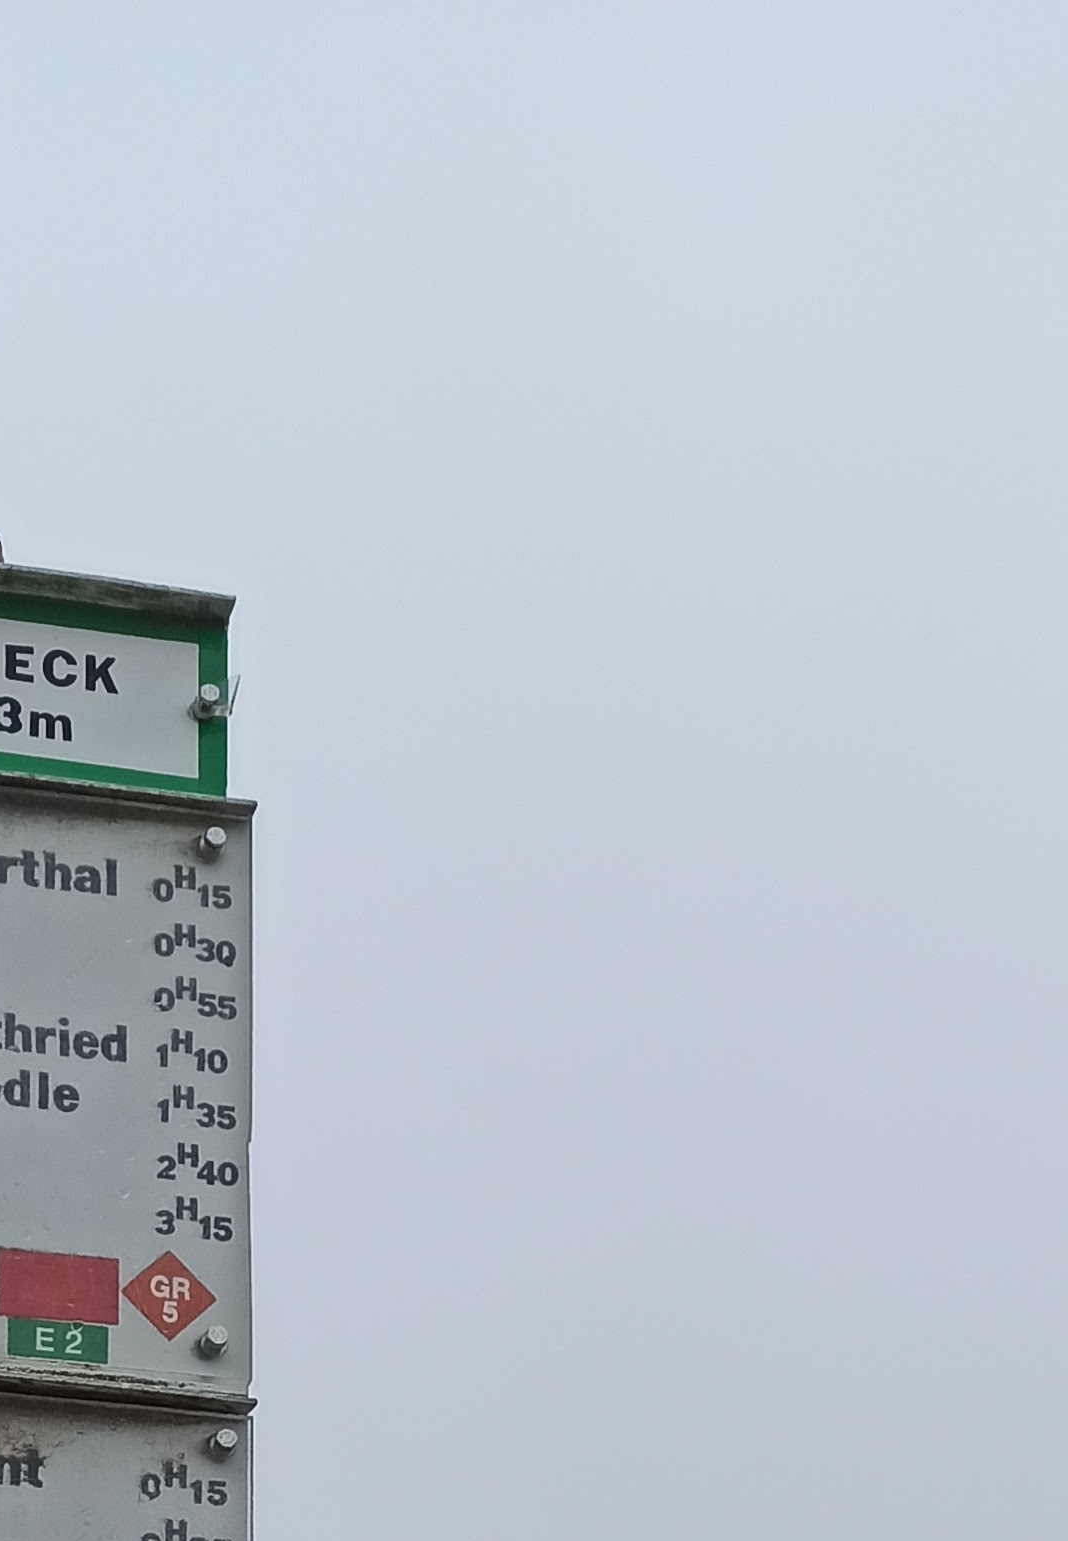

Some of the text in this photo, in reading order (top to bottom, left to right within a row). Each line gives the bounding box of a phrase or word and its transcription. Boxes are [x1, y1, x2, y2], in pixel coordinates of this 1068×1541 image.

[149, 1275, 191, 1301] GR
[162, 1302, 179, 1324] 5
[35, 1327, 82, 1355] E 2
